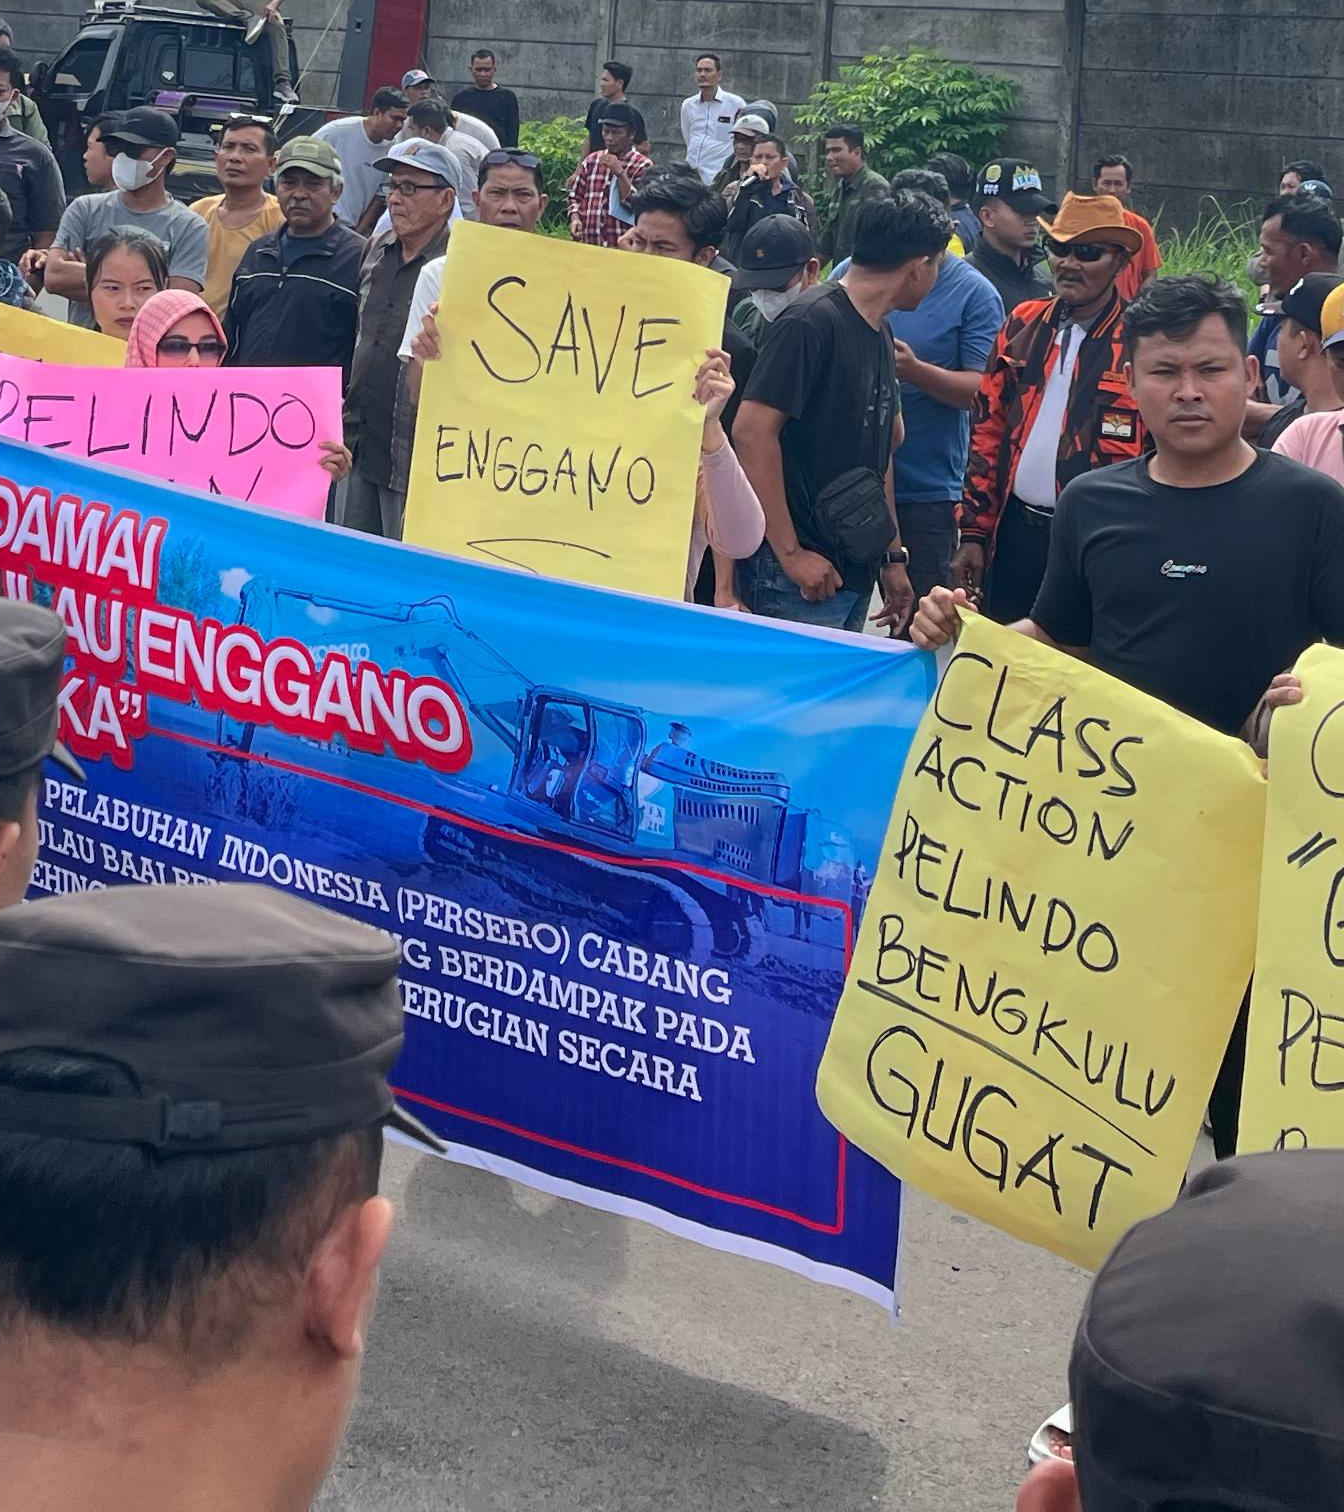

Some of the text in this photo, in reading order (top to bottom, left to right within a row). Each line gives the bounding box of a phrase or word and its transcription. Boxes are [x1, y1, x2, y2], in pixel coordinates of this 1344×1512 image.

[471, 276, 680, 398] SAVE
[435, 424, 655, 511] ENGGANO
[139, 609, 464, 753] ENGGANO
[934, 651, 1145, 797] CLASS
[914, 736, 1135, 861] ACTION
[44, 778, 212, 860] PELABUHAN
[218, 834, 390, 912] INDONESIA
[397, 886, 570, 964] (PERSERO)
[578, 932, 732, 1005] CABANG
[895, 810, 1120, 973] PELINDO
[397, 979, 550, 1057] ERUGIAN
[558, 1029, 703, 1102] SECARA
[439, 944, 647, 1035] BERDAMPAK
[655, 1006, 756, 1064] PADA
[878, 915, 1177, 1117] BENGKULU
[866, 1025, 1133, 1230] GUGAT
